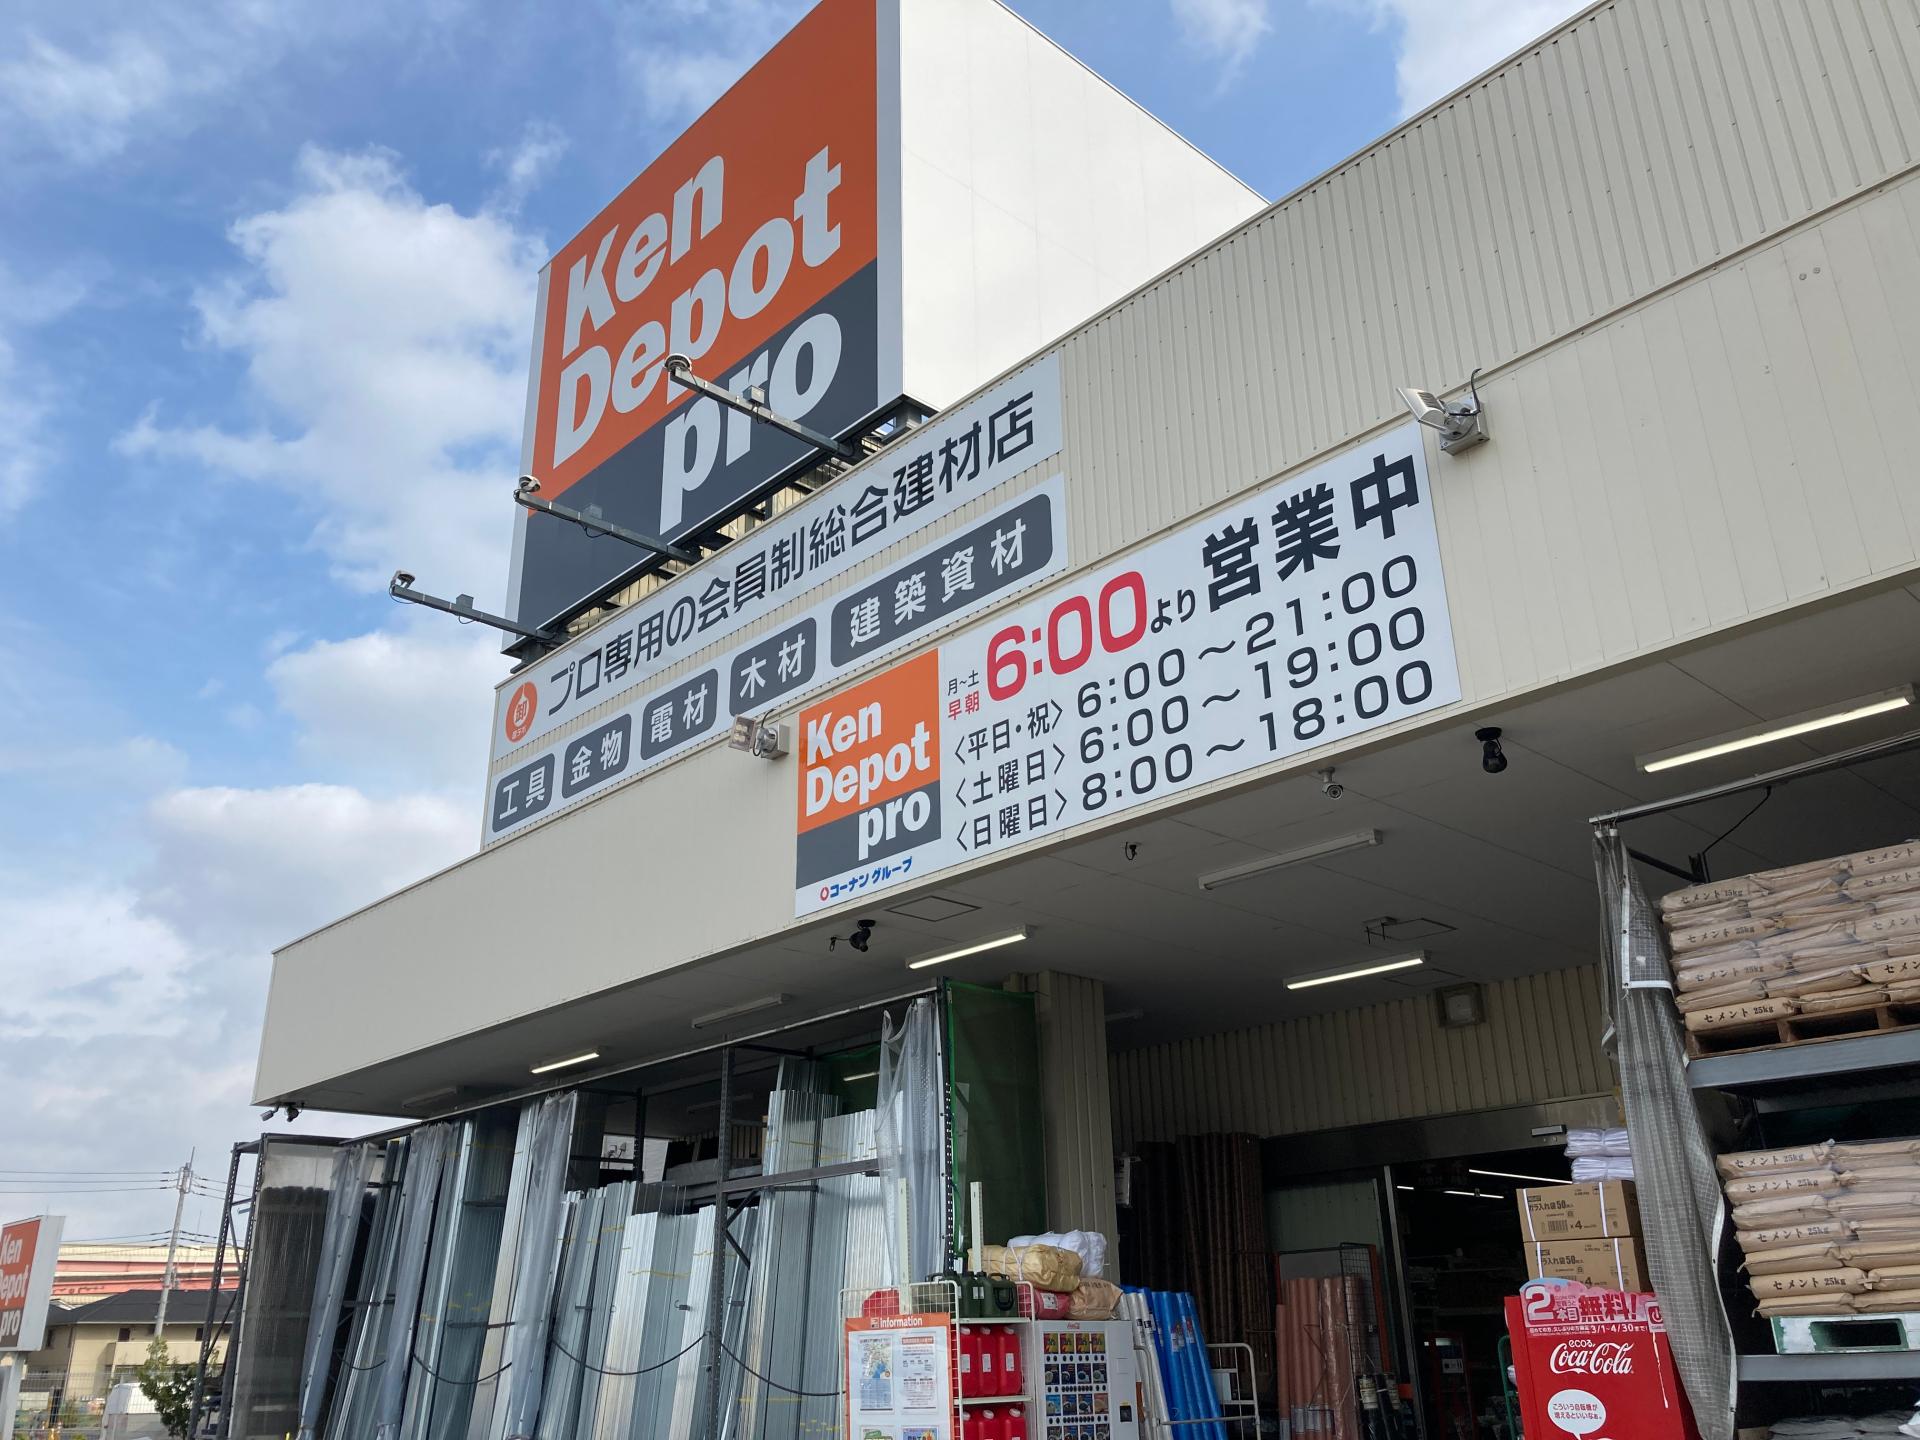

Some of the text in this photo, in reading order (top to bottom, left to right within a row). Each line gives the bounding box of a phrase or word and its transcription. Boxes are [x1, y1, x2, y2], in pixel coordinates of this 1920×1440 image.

[562, 155, 724, 359] Ken
[553, 145, 842, 470] Depot
[659, 313, 842, 536] pro
[548, 391, 1034, 716] プロ専用の会員制総合建材店
[499, 517, 1028, 820] 工具 金物 電材 木材 建築資材
[948, 690, 980, 720] 早朝
[806, 701, 882, 767] Ken
[805, 722, 931, 818] Depot
[858, 792, 931, 861] pro
[1864, 847, 1913, 864] セメント
[1864, 872, 1911, 888] セメント
[1681, 890, 1720, 904] セメント
[1687, 928, 1729, 943] セメント
[1696, 967, 1738, 982] セメント
[1704, 1005, 1774, 1023] セメント 25kg
[1735, 1154, 1804, 1168] セメント 25kg
[1747, 1179, 1819, 1193] セメント 25kg
[1758, 1226, 1829, 1242] セメント 25kg
[1, 1233, 23, 1265] Ken
[1773, 1277, 1846, 1290] セメント 25kg
[0, 1308, 21, 1337] pro
[880, 1316, 923, 1328] information
[1549, 1342, 1635, 1374] Coca-Cola
